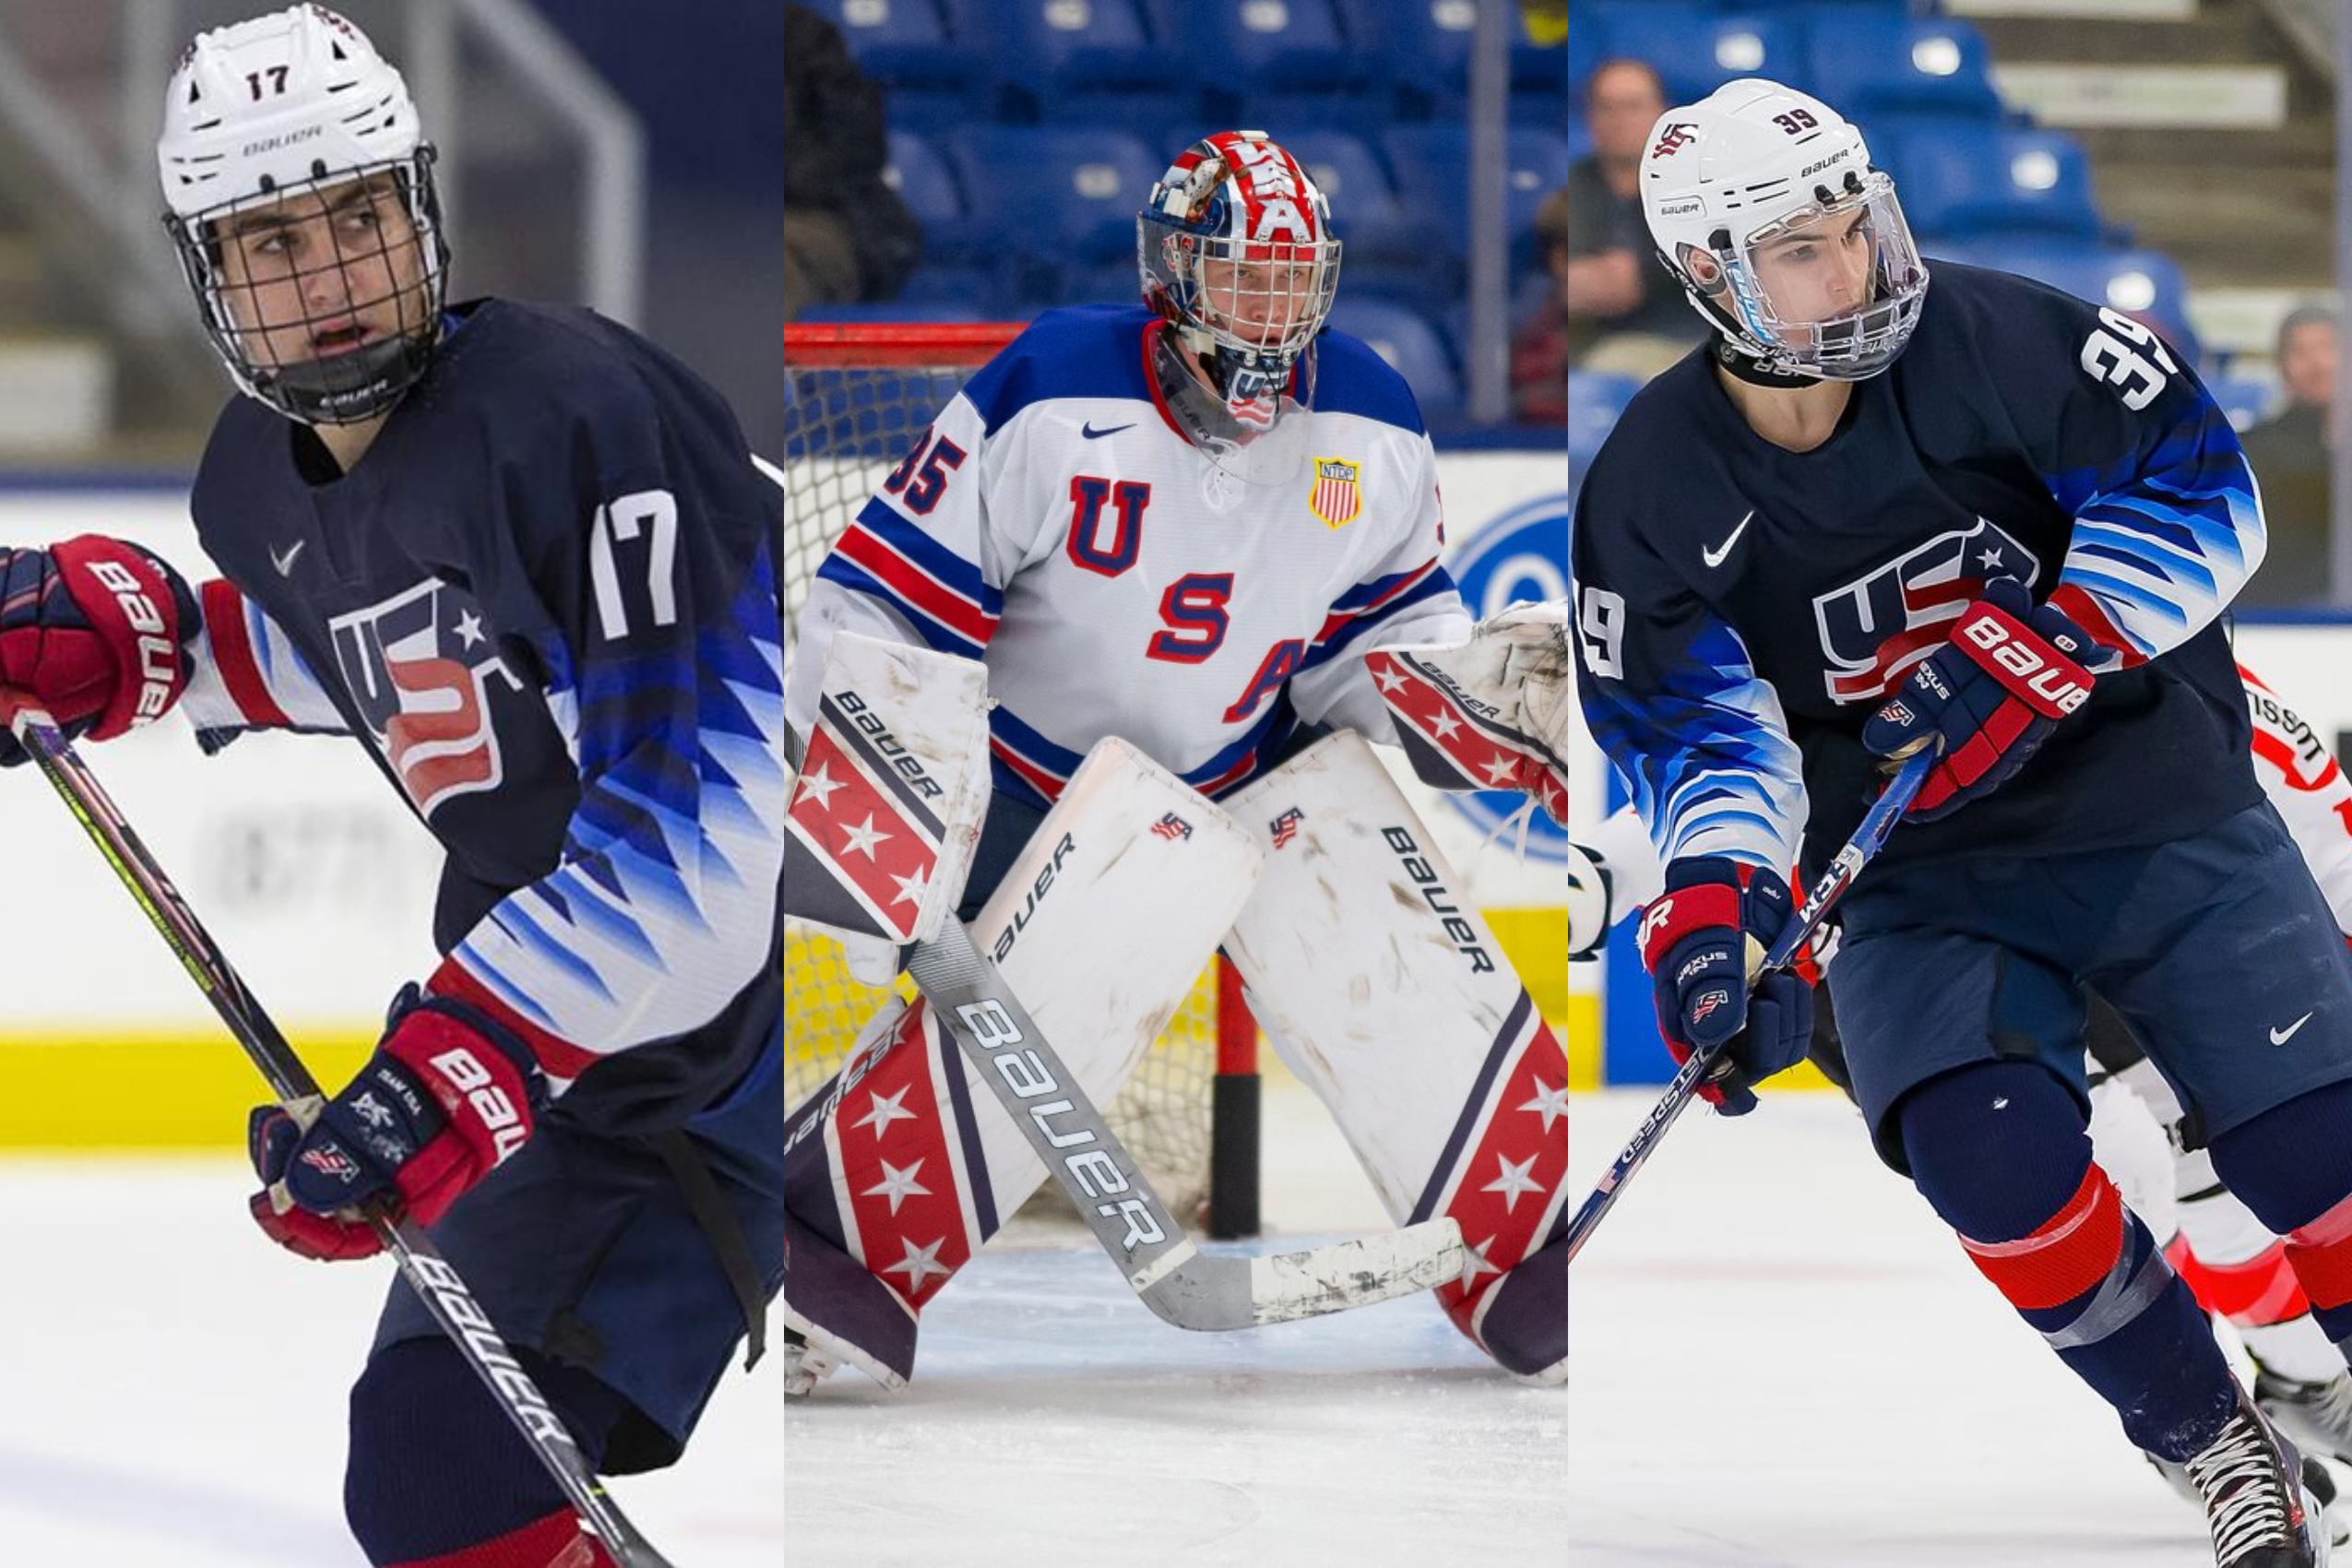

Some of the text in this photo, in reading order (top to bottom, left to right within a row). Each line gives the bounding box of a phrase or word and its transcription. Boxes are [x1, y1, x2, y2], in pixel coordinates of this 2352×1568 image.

[245, 65, 290, 101] 17
[1772, 109, 1818, 135] 39
[1801, 148, 1849, 178] BAUER
[2081, 307, 2179, 411] 39
[1323, 463, 1354, 481] NTDP
[590, 489, 678, 640] 17
[85, 561, 174, 728] BAUE
[1572, 576, 1625, 680] 9
[1918, 659, 1951, 700] EXUS
[1964, 615, 2091, 715] BAUE
[1421, 660, 1501, 719] BAUER
[835, 690, 944, 800] BAUER
[985, 831, 1076, 968] AUER
[1380, 826, 1496, 974] BAUER
[428, 1048, 528, 1170] BAU
[955, 999, 1167, 1253] BAUER
[409, 1253, 576, 1446] BAUER
